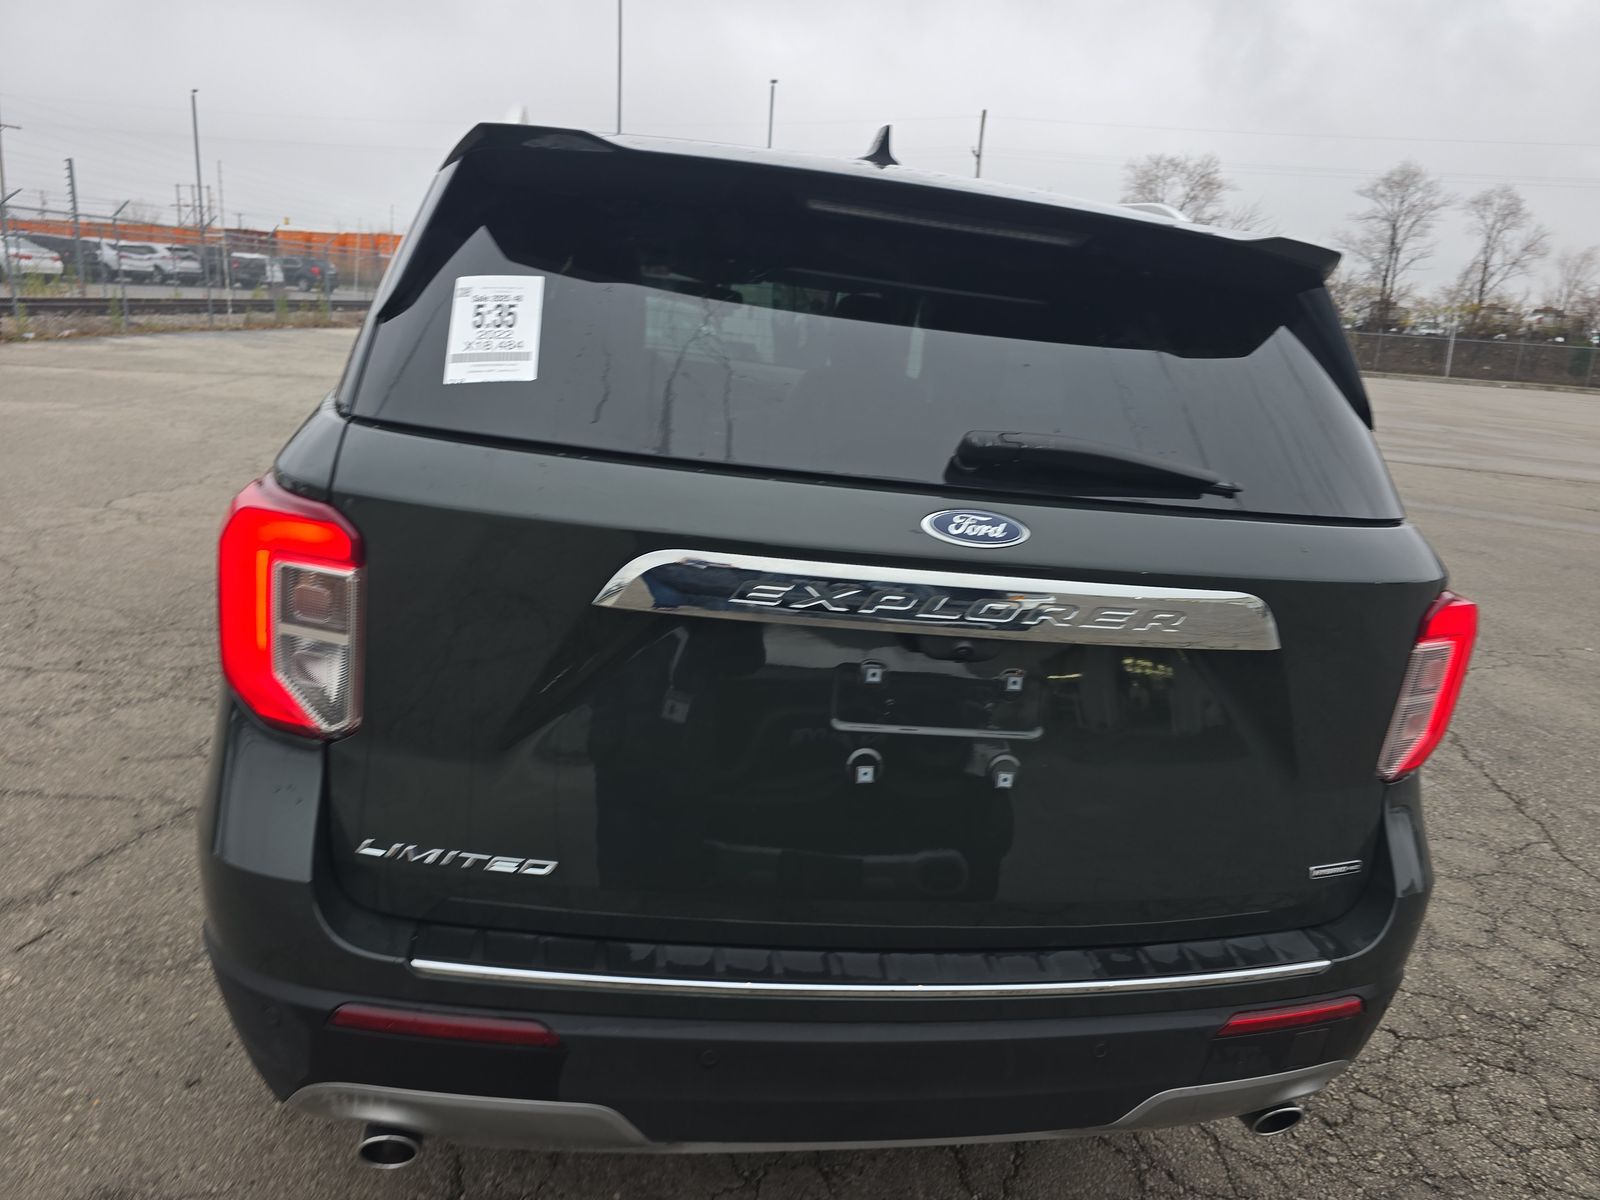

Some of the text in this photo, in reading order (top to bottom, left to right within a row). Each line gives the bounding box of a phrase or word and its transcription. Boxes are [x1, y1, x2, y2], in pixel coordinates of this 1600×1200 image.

[947, 513, 1008, 538] Ford
[727, 579, 1188, 633] EXPLORER
[354, 838, 559, 876] LIMITED
